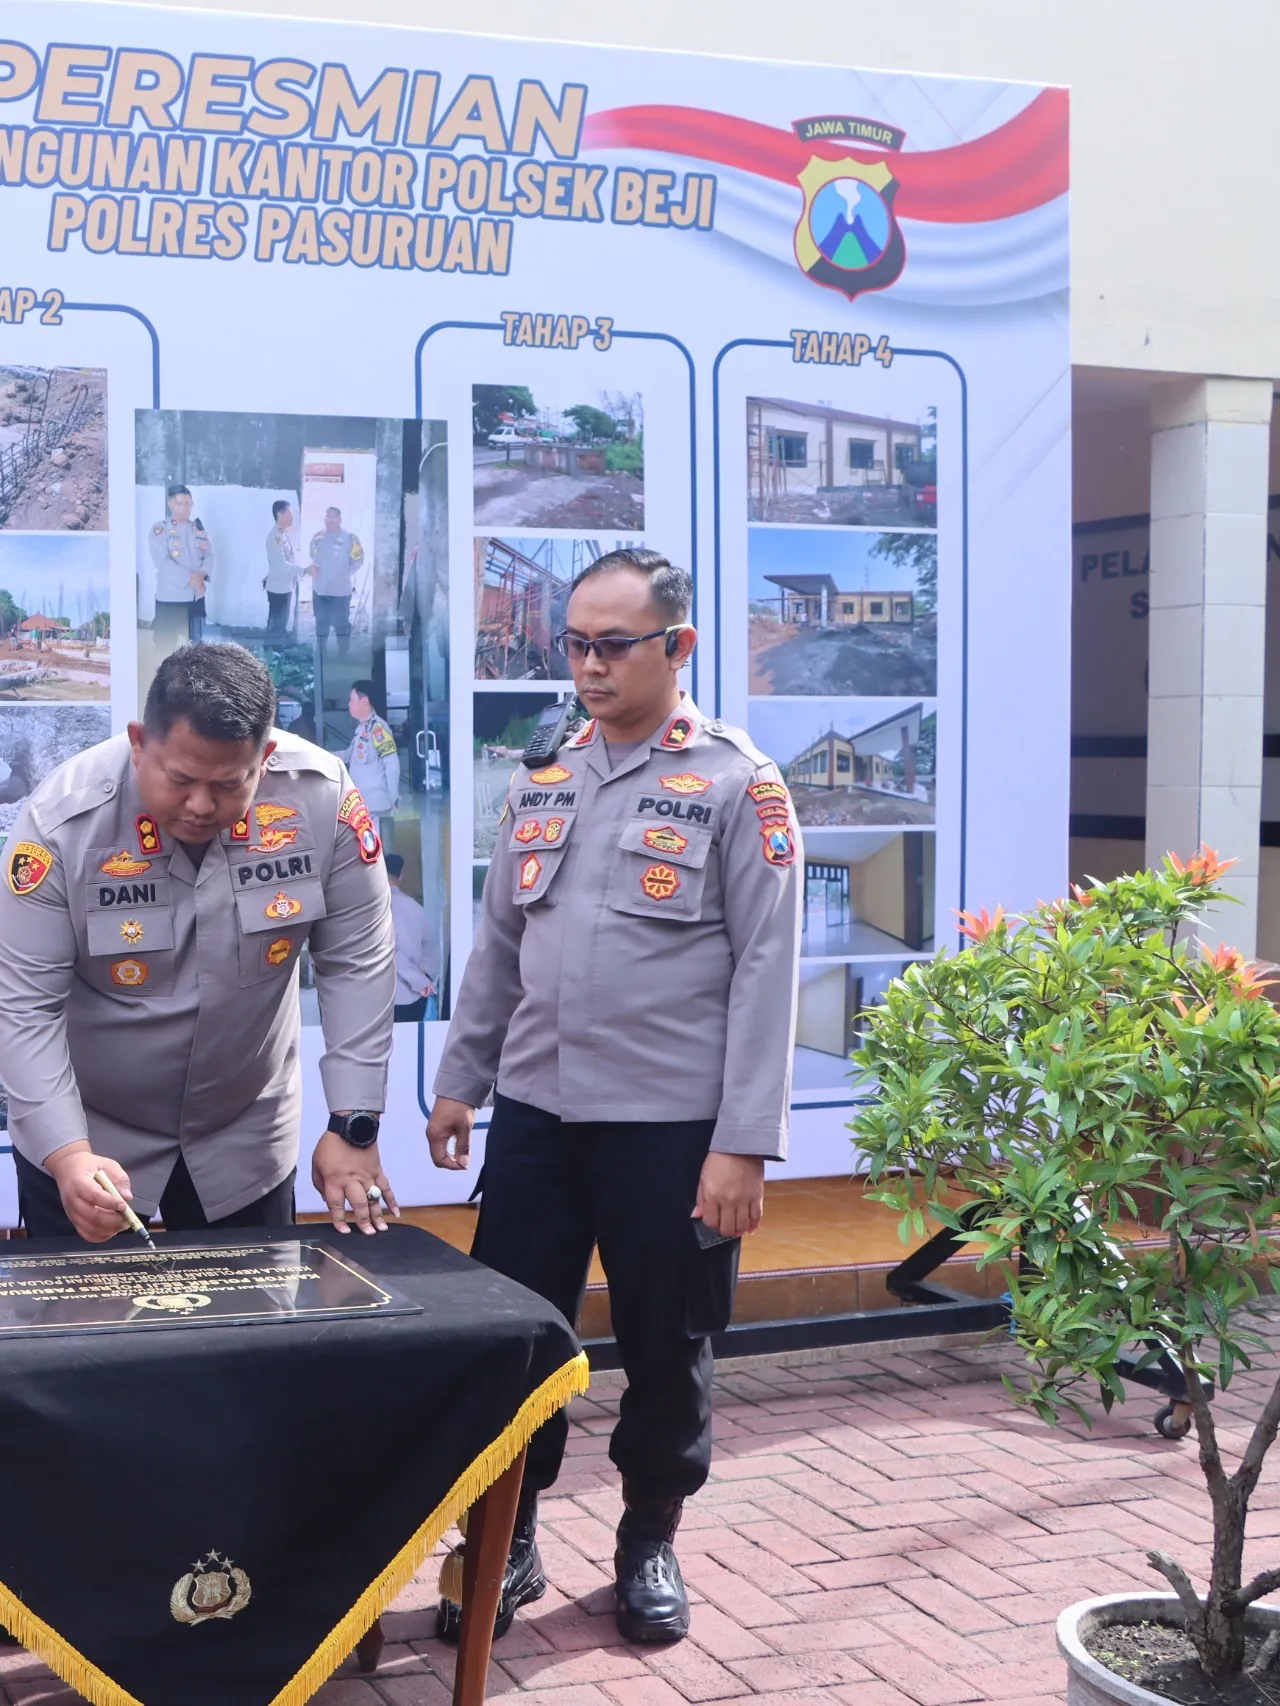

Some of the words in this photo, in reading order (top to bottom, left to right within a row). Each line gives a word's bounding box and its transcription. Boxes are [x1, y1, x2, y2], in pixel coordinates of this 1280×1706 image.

[805, 121, 845, 137] JAWA
[848, 122, 893, 144] TIMUR
[211, 139, 417, 211] KANTOR
[425, 154, 611, 225] POLSEK
[612, 168, 720, 232] BEJI
[47, 193, 248, 261] POLRES
[254, 206, 514, 276] PASURUAN
[37, 289, 63, 325] 2
[501, 311, 590, 351] TAHAP
[591, 317, 614, 351] 3
[790, 330, 871, 366] TAHAP
[872, 334, 894, 368] 4
[519, 791, 552, 808] ANDY
[553, 791, 576, 807] PM
[638, 797, 712, 825] POLRI
[238, 855, 311, 886] POLRI
[99, 884, 156, 907] DANI
[184, 1269, 260, 1277] KEPOLISIAN
[252, 1274, 321, 1283] KANTOR
[260, 1266, 313, 1274] KEPALA
